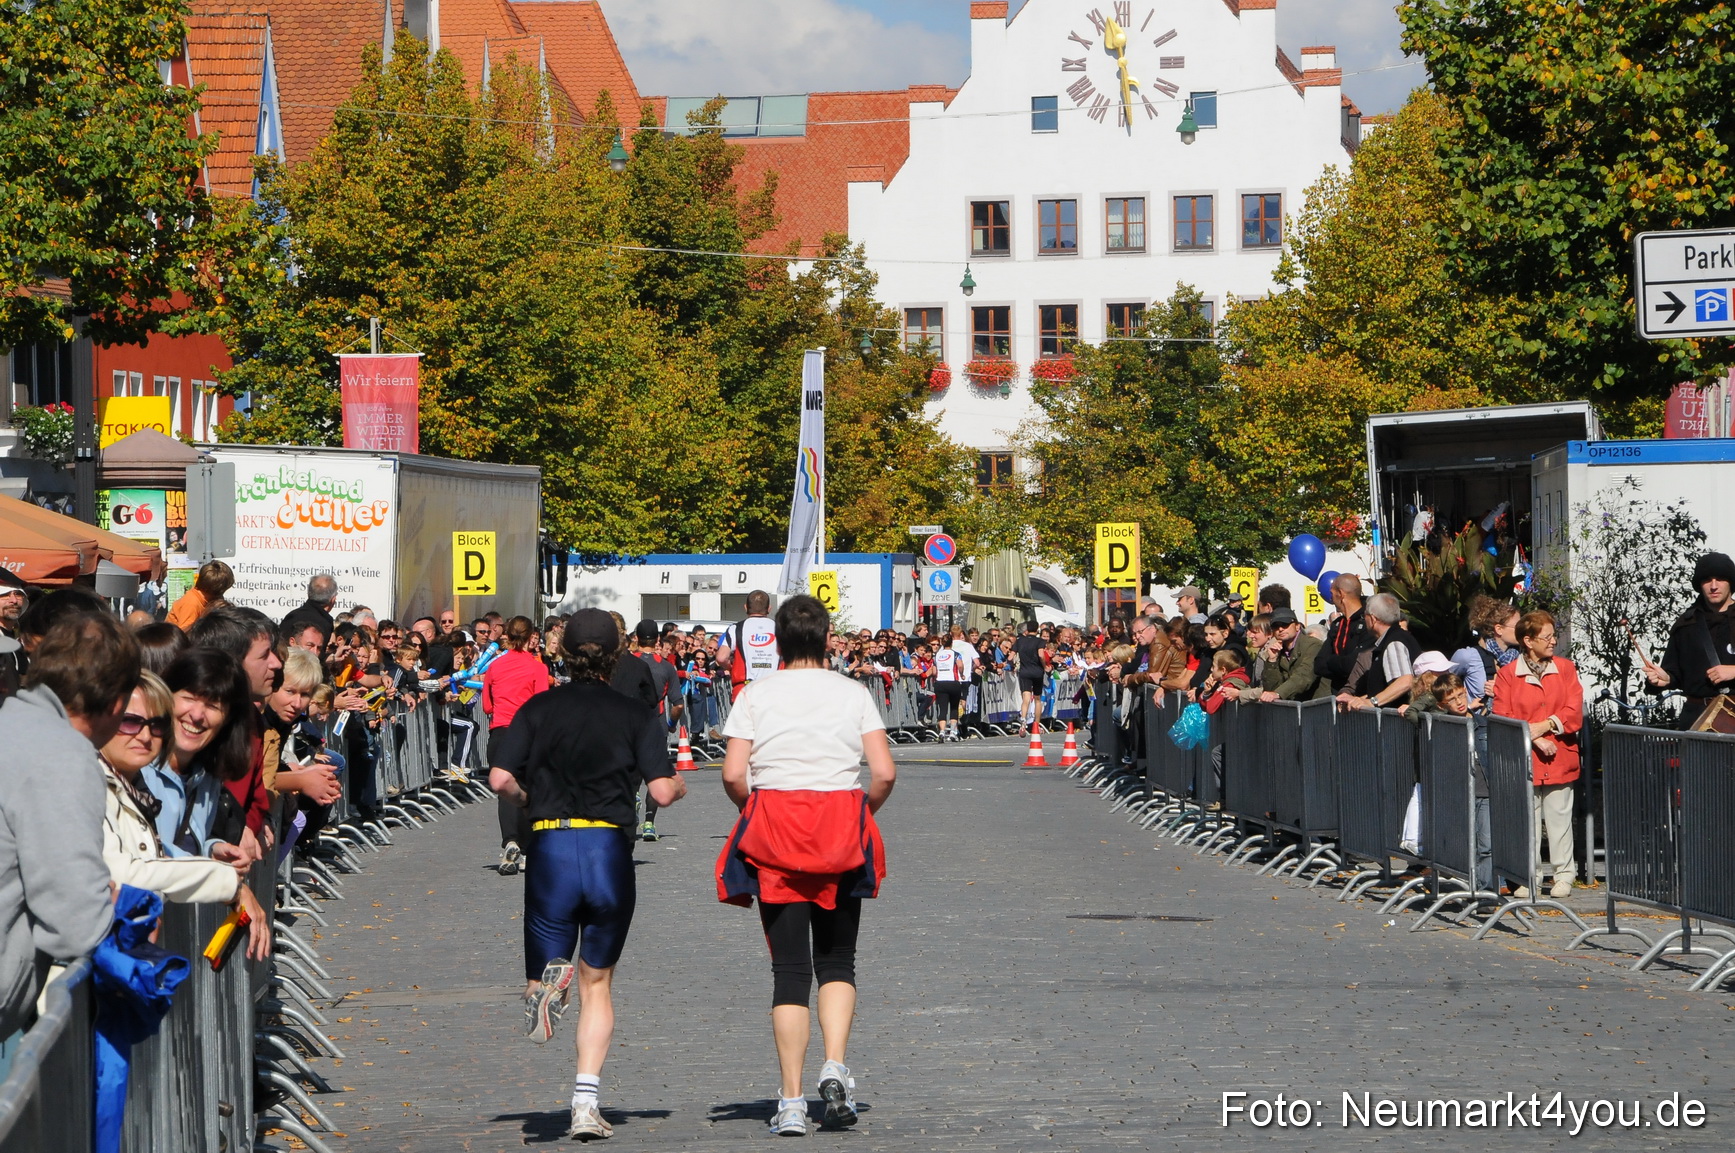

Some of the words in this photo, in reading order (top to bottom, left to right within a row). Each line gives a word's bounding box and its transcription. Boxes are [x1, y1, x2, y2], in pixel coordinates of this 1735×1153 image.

[1684, 243, 1735, 270] Park
[345, 373, 371, 386] Wir
[375, 372, 415, 386] feiern
[357, 413, 404, 424] IMMER
[356, 425, 406, 436] WIEDER
[360, 437, 402, 451] NEU
[1589, 447, 1642, 458] OP12136
[112, 503, 153, 525] G6
[277, 488, 389, 534] Müller
[235, 514, 276, 529] ARKT'S
[1102, 526, 1135, 538] Block
[241, 534, 369, 553] GETRÄNKESPEZIALIST
[458, 534, 491, 546] Block
[0, 556, 26, 573] ier
[1108, 543, 1130, 573] D
[352, 566, 381, 578] Weine
[464, 551, 486, 581] D
[661, 571, 670, 584] H
[738, 571, 747, 584] D
[811, 573, 834, 582] Block
[1233, 569, 1256, 578] Block
[232, 579, 291, 593] endgetränke
[1236, 580, 1251, 601] C
[816, 583, 832, 604] C
[931, 594, 951, 602] ZONE
[1309, 594, 1319, 607] B
[750, 633, 768, 642] tkn
